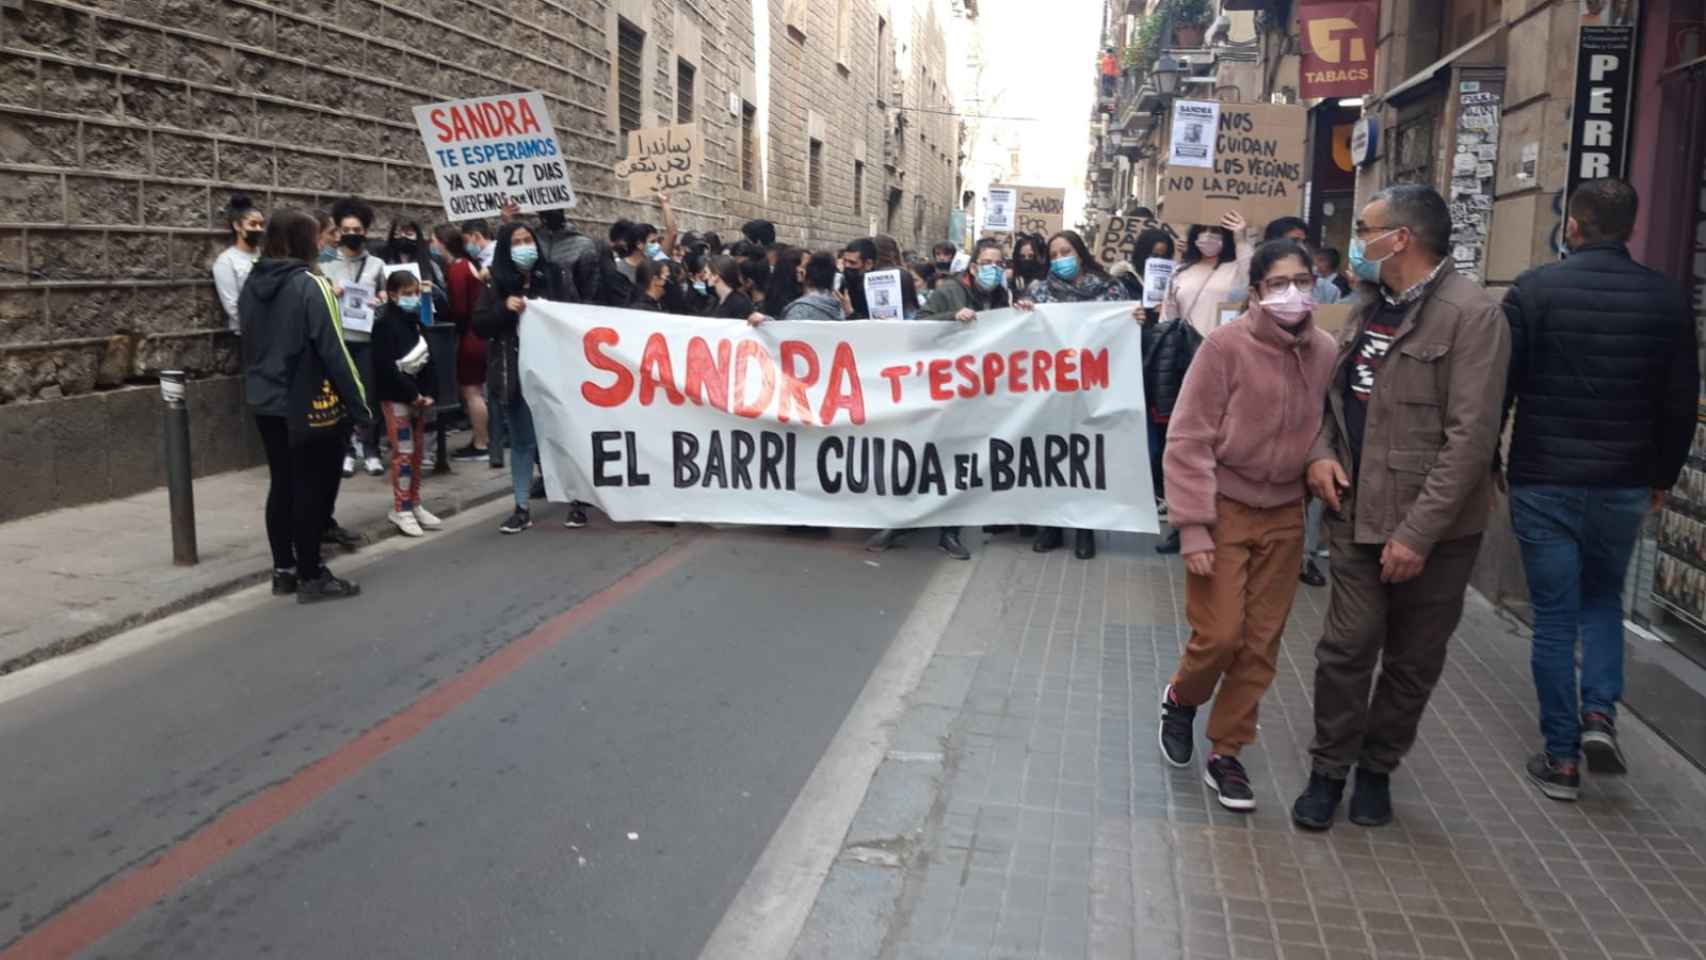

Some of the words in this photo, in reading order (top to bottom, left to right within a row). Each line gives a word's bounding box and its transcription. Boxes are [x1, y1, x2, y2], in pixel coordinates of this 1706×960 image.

[1305, 69, 1368, 84] TABACS
[430, 96, 541, 142] SANDRA
[1219, 111, 1254, 133] NOS
[1580, 54, 1619, 178] PERR
[435, 149, 459, 167] TE
[461, 138, 557, 164] ESPERAMOS
[1214, 158, 1244, 175] LOS
[443, 173, 465, 191] YA
[468, 168, 498, 188] SON
[504, 163, 524, 186] 27
[532, 162, 563, 181] DIAS
[1168, 176, 1194, 191] NO
[1203, 177, 1222, 191] LA
[525, 184, 570, 206] VUELVAS
[581, 326, 865, 426] SANDRA
[880, 347, 1110, 403] T'ESPEREM
[591, 430, 650, 487] EL
[672, 429, 796, 491] BARRI
[816, 435, 948, 497] CUIDA
[954, 452, 984, 491] EL
[989, 433, 1107, 492] BARRI
